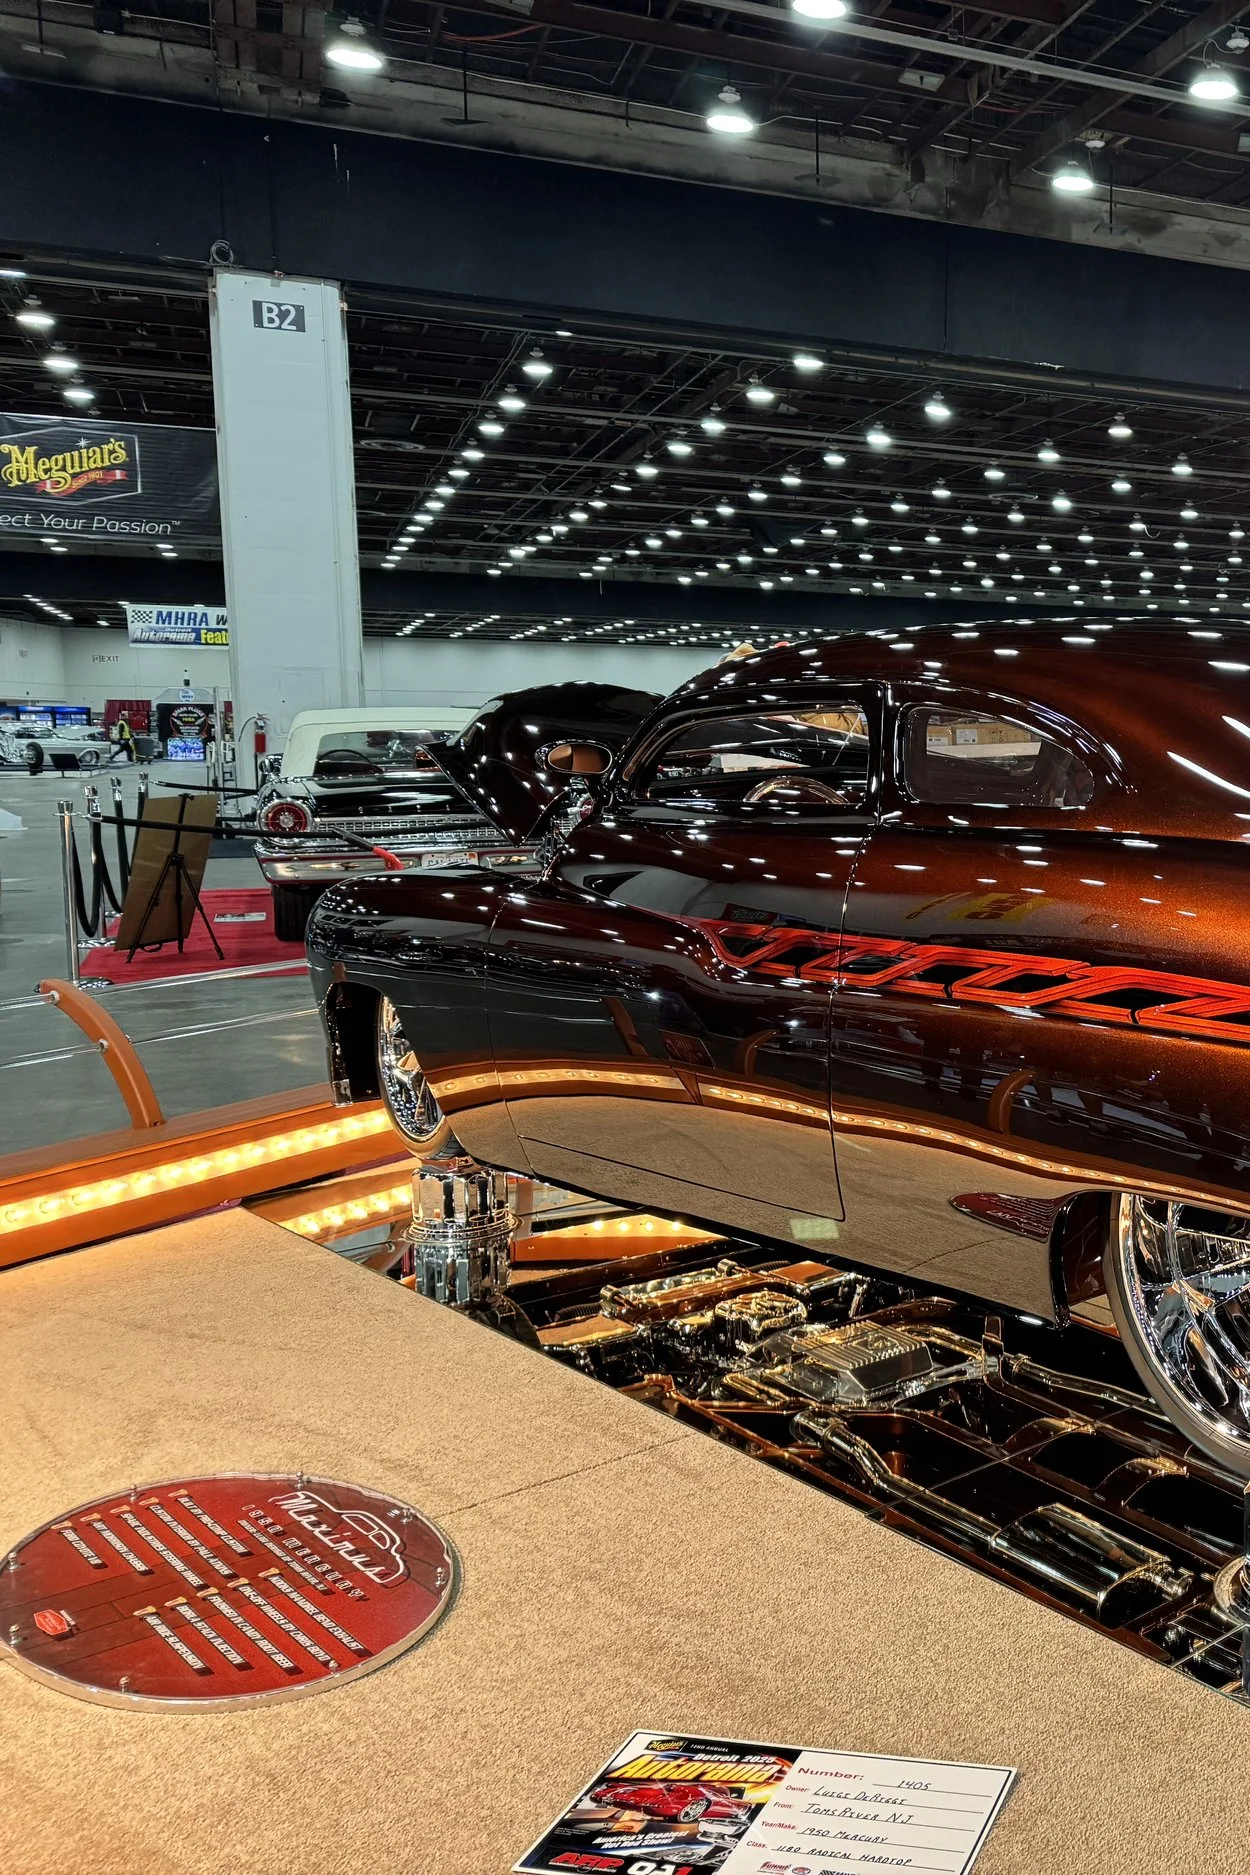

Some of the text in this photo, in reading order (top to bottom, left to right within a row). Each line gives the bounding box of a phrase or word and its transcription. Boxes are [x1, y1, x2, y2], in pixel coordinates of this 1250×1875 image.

[261, 302, 297, 331] B2
[0, 437, 128, 493] Meguiar's
[39, 513, 87, 531] Your
[155, 610, 209, 626] MHRA
[133, 627, 197, 643] Autorama
[150, 1505, 173, 1522] CUSTOM
[167, 1521, 194, 1541] INTERIOR
[72, 1541, 94, 1558] COYOTE
[100, 1530, 129, 1553] MORRISON
[122, 1552, 148, 1572] CHASSIS
[221, 1535, 246, 1553] CUSTOM
[242, 1504, 364, 1598] 1950 MERCURY
[136, 1527, 166, 1551] INDUSTRIES
[160, 1550, 188, 1571] STEERING
[181, 1571, 203, 1586] WHEEL
[239, 1586, 330, 1661] ONE-OFF WHEELS BY CHRIS BOYD
[287, 1592, 321, 1615] MANDREL
[313, 1614, 336, 1628] BEND
[329, 1627, 362, 1651] EXHAUST
[208, 1596, 238, 1618] FINISHED
[237, 1623, 263, 1640] CANDY
[255, 1639, 278, 1654] ROOT
[270, 1654, 293, 1669] BEER
[145, 1615, 205, 1669] AIR RIDE SUSPENSION
[194, 1621, 218, 1638] STACK
[210, 1637, 244, 1665] INJECTION
[693, 1753, 777, 1764] Detroit 2025
[608, 1753, 782, 1783] Autorama
[797, 1767, 865, 1781] Number:
[785, 1785, 811, 1793] Owner:
[897, 1780, 933, 1790] 1405
[773, 1802, 795, 1810] From:
[761, 1820, 798, 1831] Year/Make:
[801, 1826, 831, 1837] 1950
[592, 1830, 690, 1844] America's Greatest
[549, 1852, 625, 1869] ARP
[806, 1848, 853, 1861] RADICAL
[858, 1854, 913, 1867] HARDTOP
